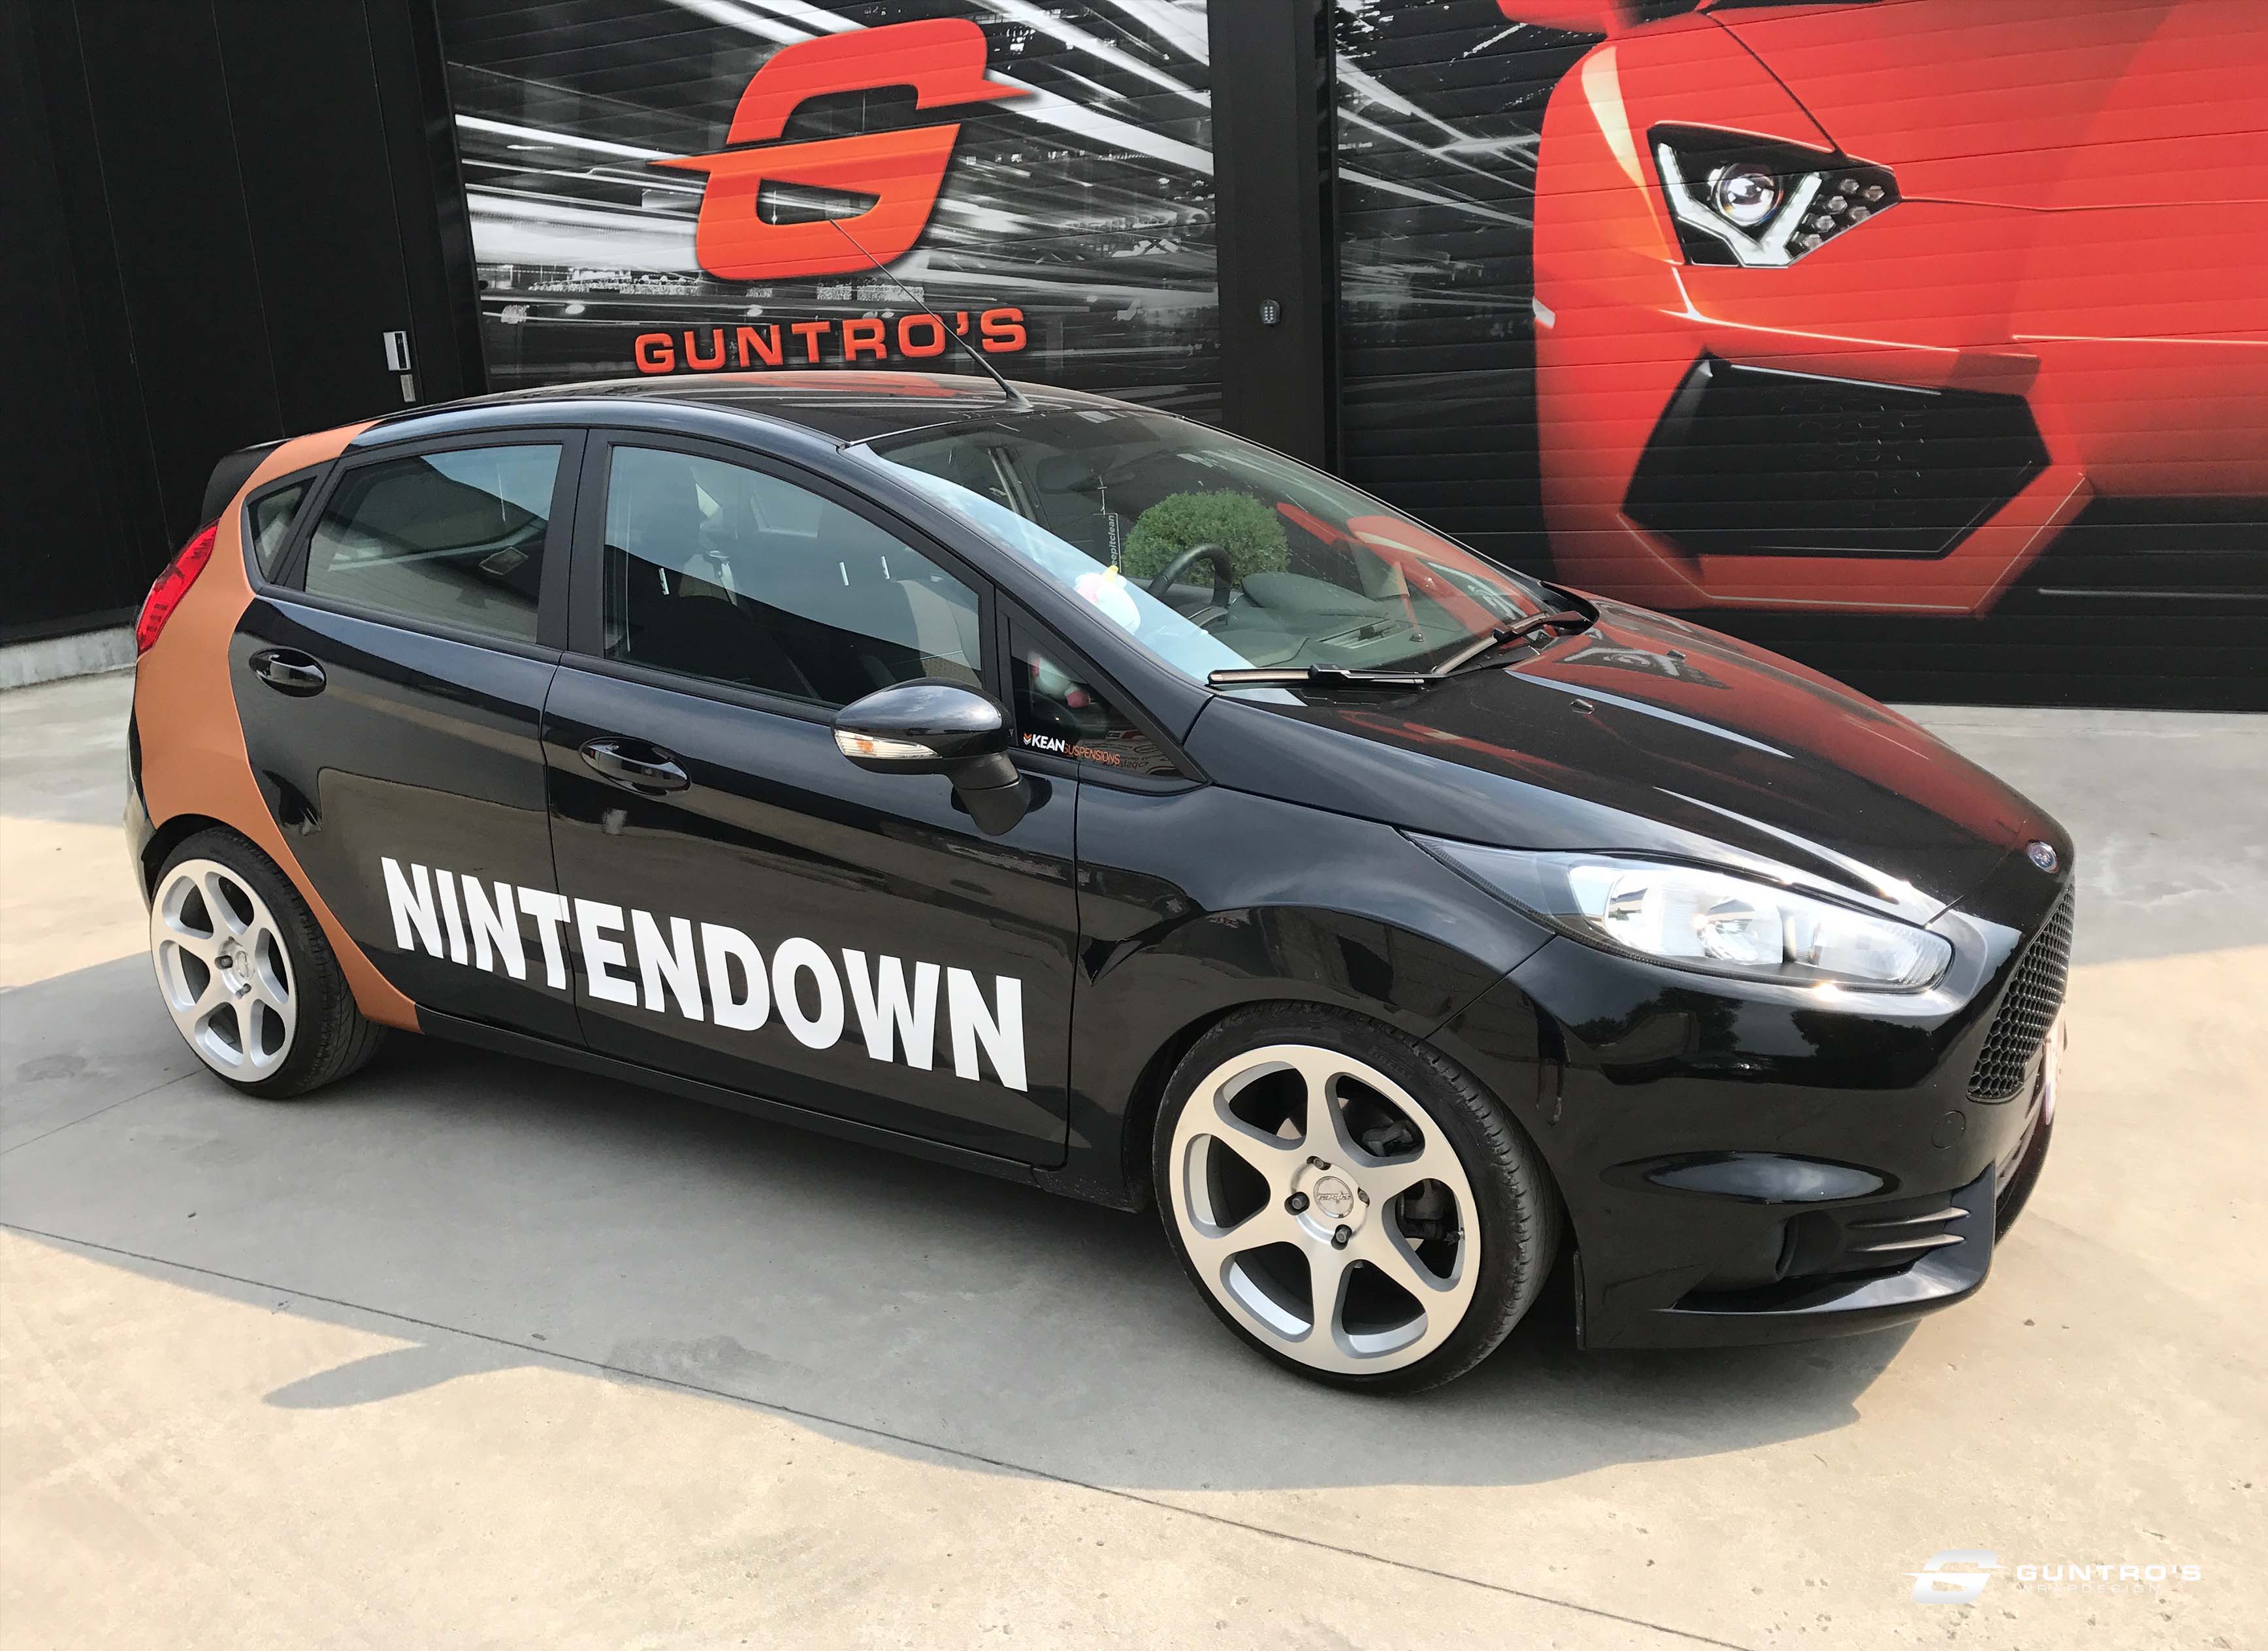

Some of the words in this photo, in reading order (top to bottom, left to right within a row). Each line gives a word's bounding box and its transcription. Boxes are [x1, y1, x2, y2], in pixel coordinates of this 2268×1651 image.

[635, 307, 1028, 374] GUNTRO'S
[1109, 515, 1118, 566] eepitclean
[1032, 734, 1065, 752] KEAN
[1064, 743, 1120, 764] SUSPENSIONS
[381, 857, 1028, 1091] NINTENDOWN
